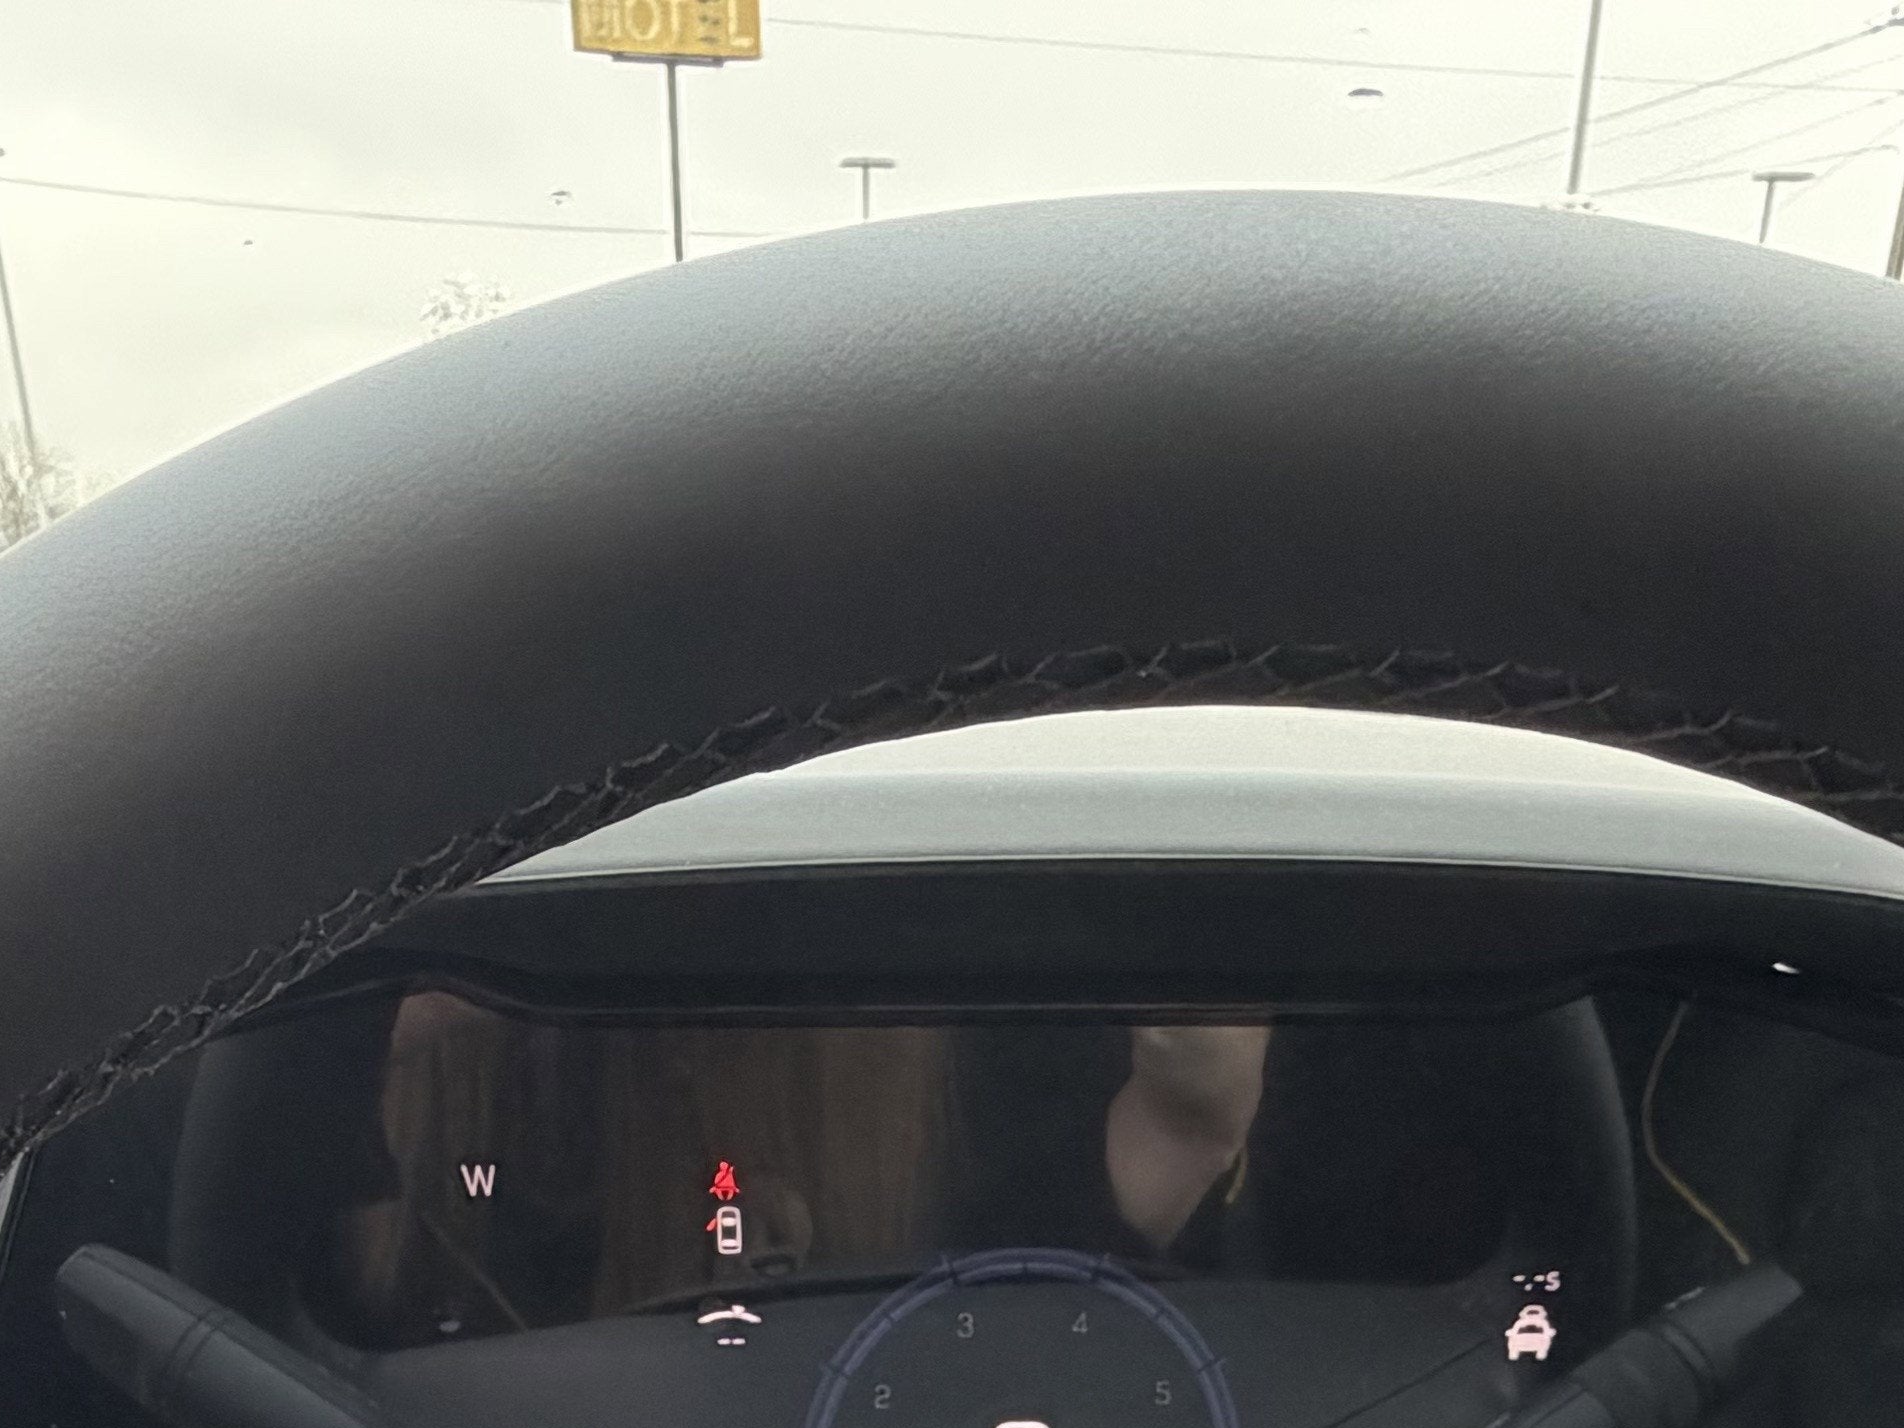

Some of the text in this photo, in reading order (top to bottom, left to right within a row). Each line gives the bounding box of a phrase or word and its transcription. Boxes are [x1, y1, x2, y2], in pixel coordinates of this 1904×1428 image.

[460, 1164, 496, 1197] W
[957, 1314, 974, 1338] 3
[1072, 1313, 1089, 1336] 4
[874, 1384, 891, 1409] 2
[1155, 1381, 1172, 1406] 5
